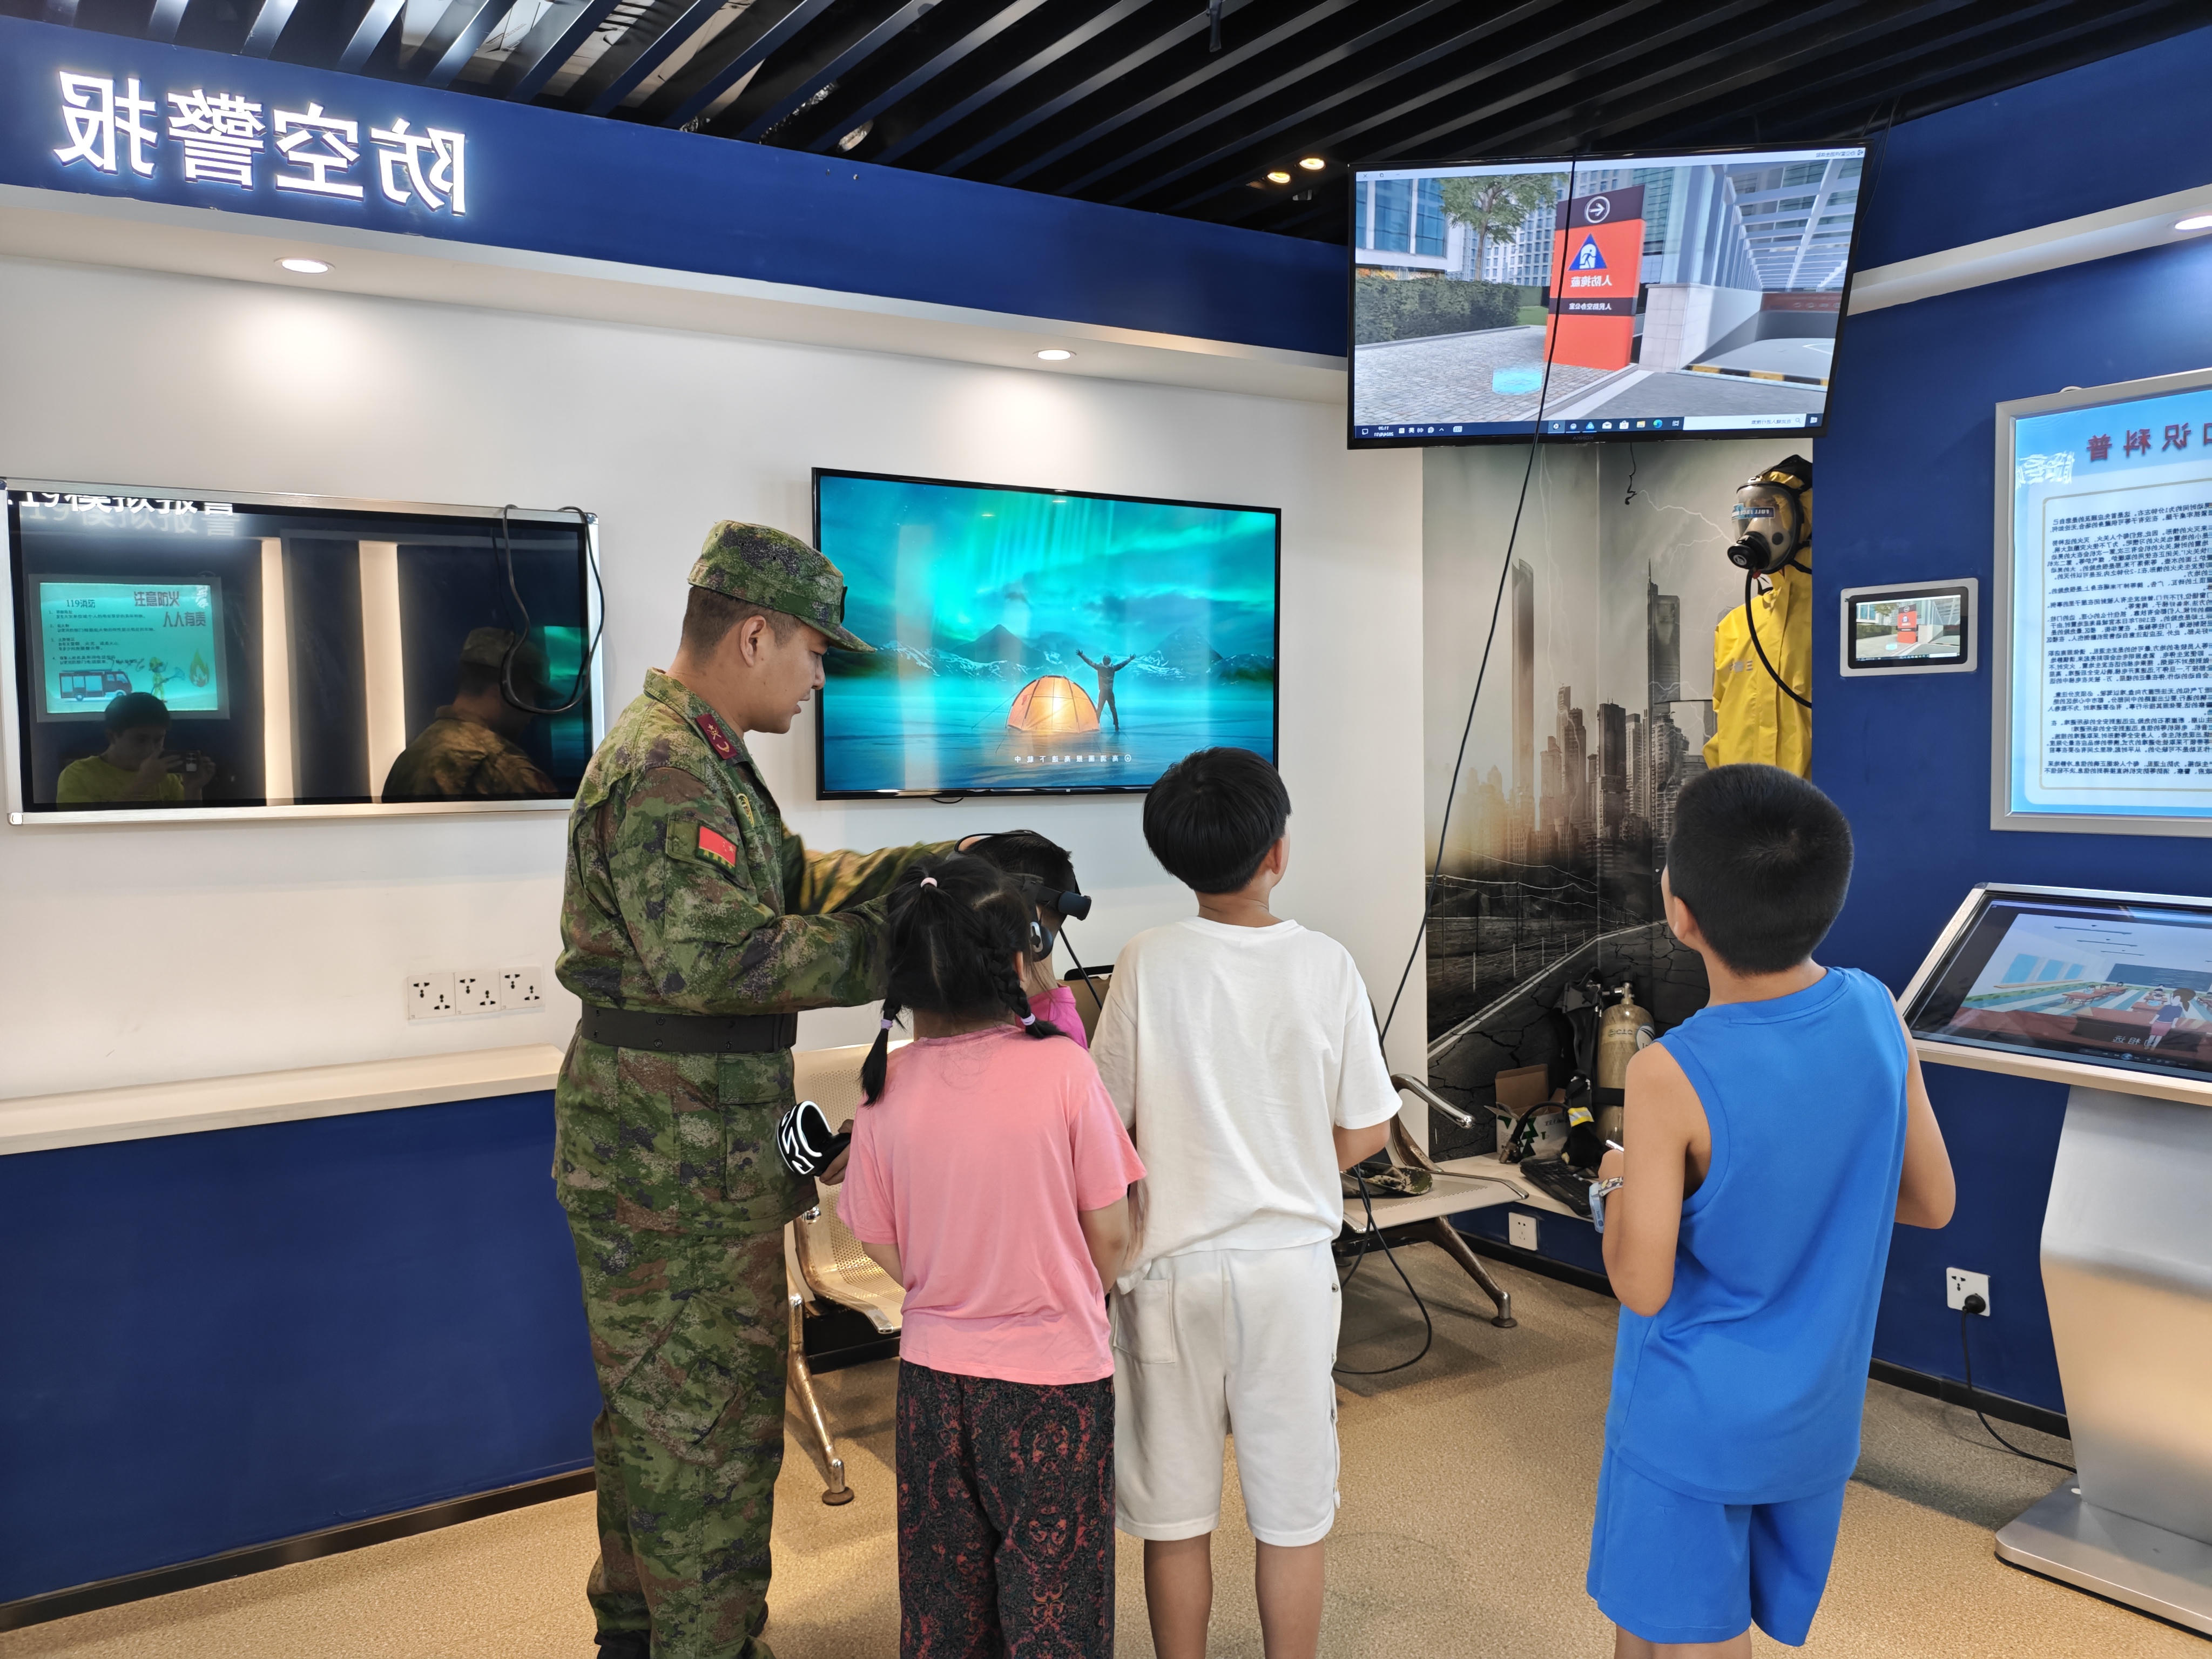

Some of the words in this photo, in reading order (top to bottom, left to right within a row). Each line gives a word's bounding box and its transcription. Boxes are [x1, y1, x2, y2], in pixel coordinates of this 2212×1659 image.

[66, 599, 96, 608] 119消防
[134, 590, 180, 607] 注意防火
[163, 611, 206, 627] 人人有责
